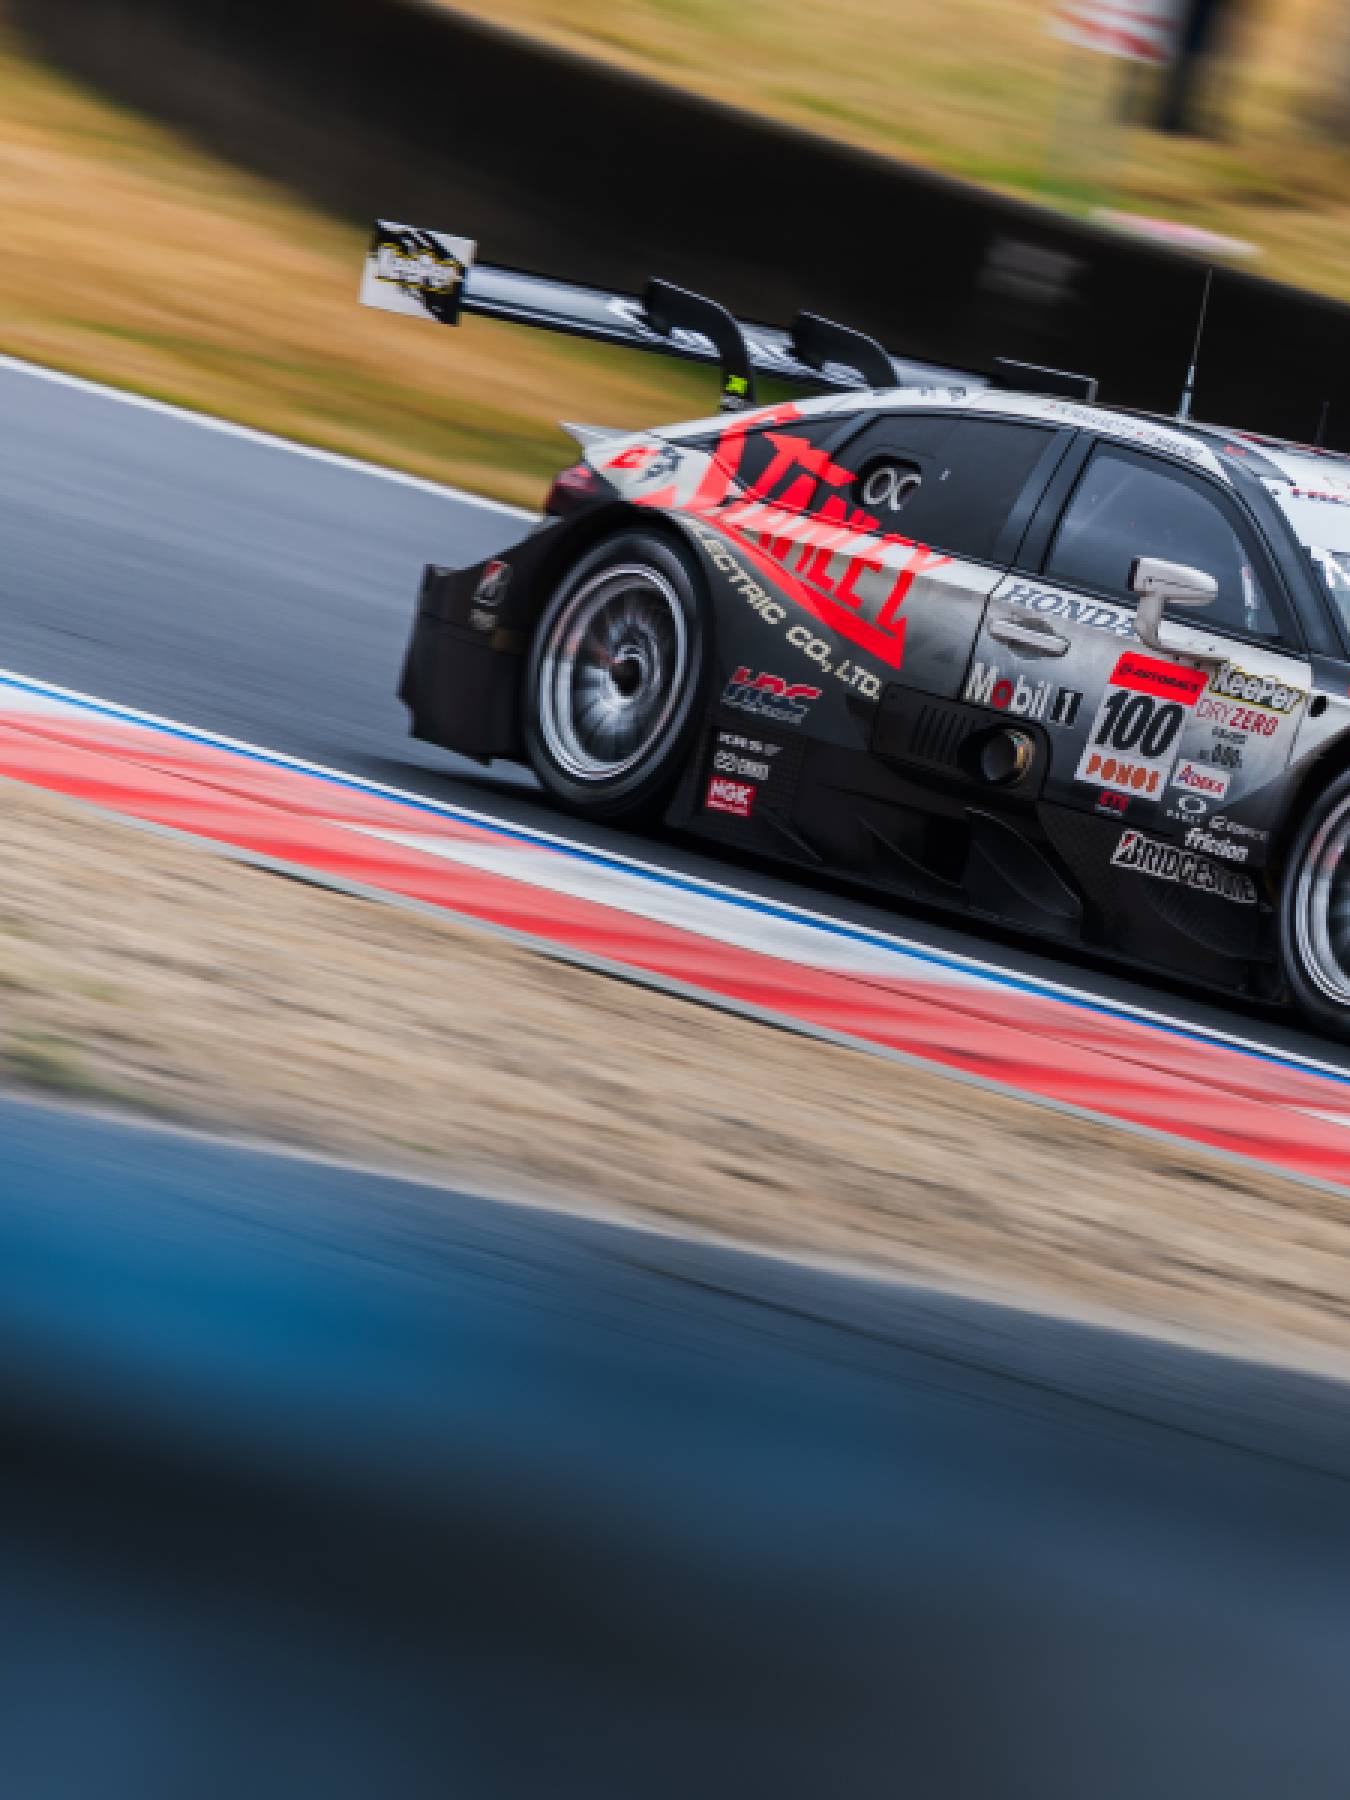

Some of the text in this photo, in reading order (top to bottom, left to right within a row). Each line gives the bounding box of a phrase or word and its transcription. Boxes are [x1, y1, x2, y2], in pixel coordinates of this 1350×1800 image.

[686, 516, 787, 626] LECTRIC
[963, 661, 1053, 720] Mobil
[1212, 661, 1304, 713] KeePer
[1094, 688, 1186, 760] 100
[1196, 697, 1233, 726] DRY
[1229, 707, 1280, 738] ZERO
[1085, 752, 1161, 794] PONOS
